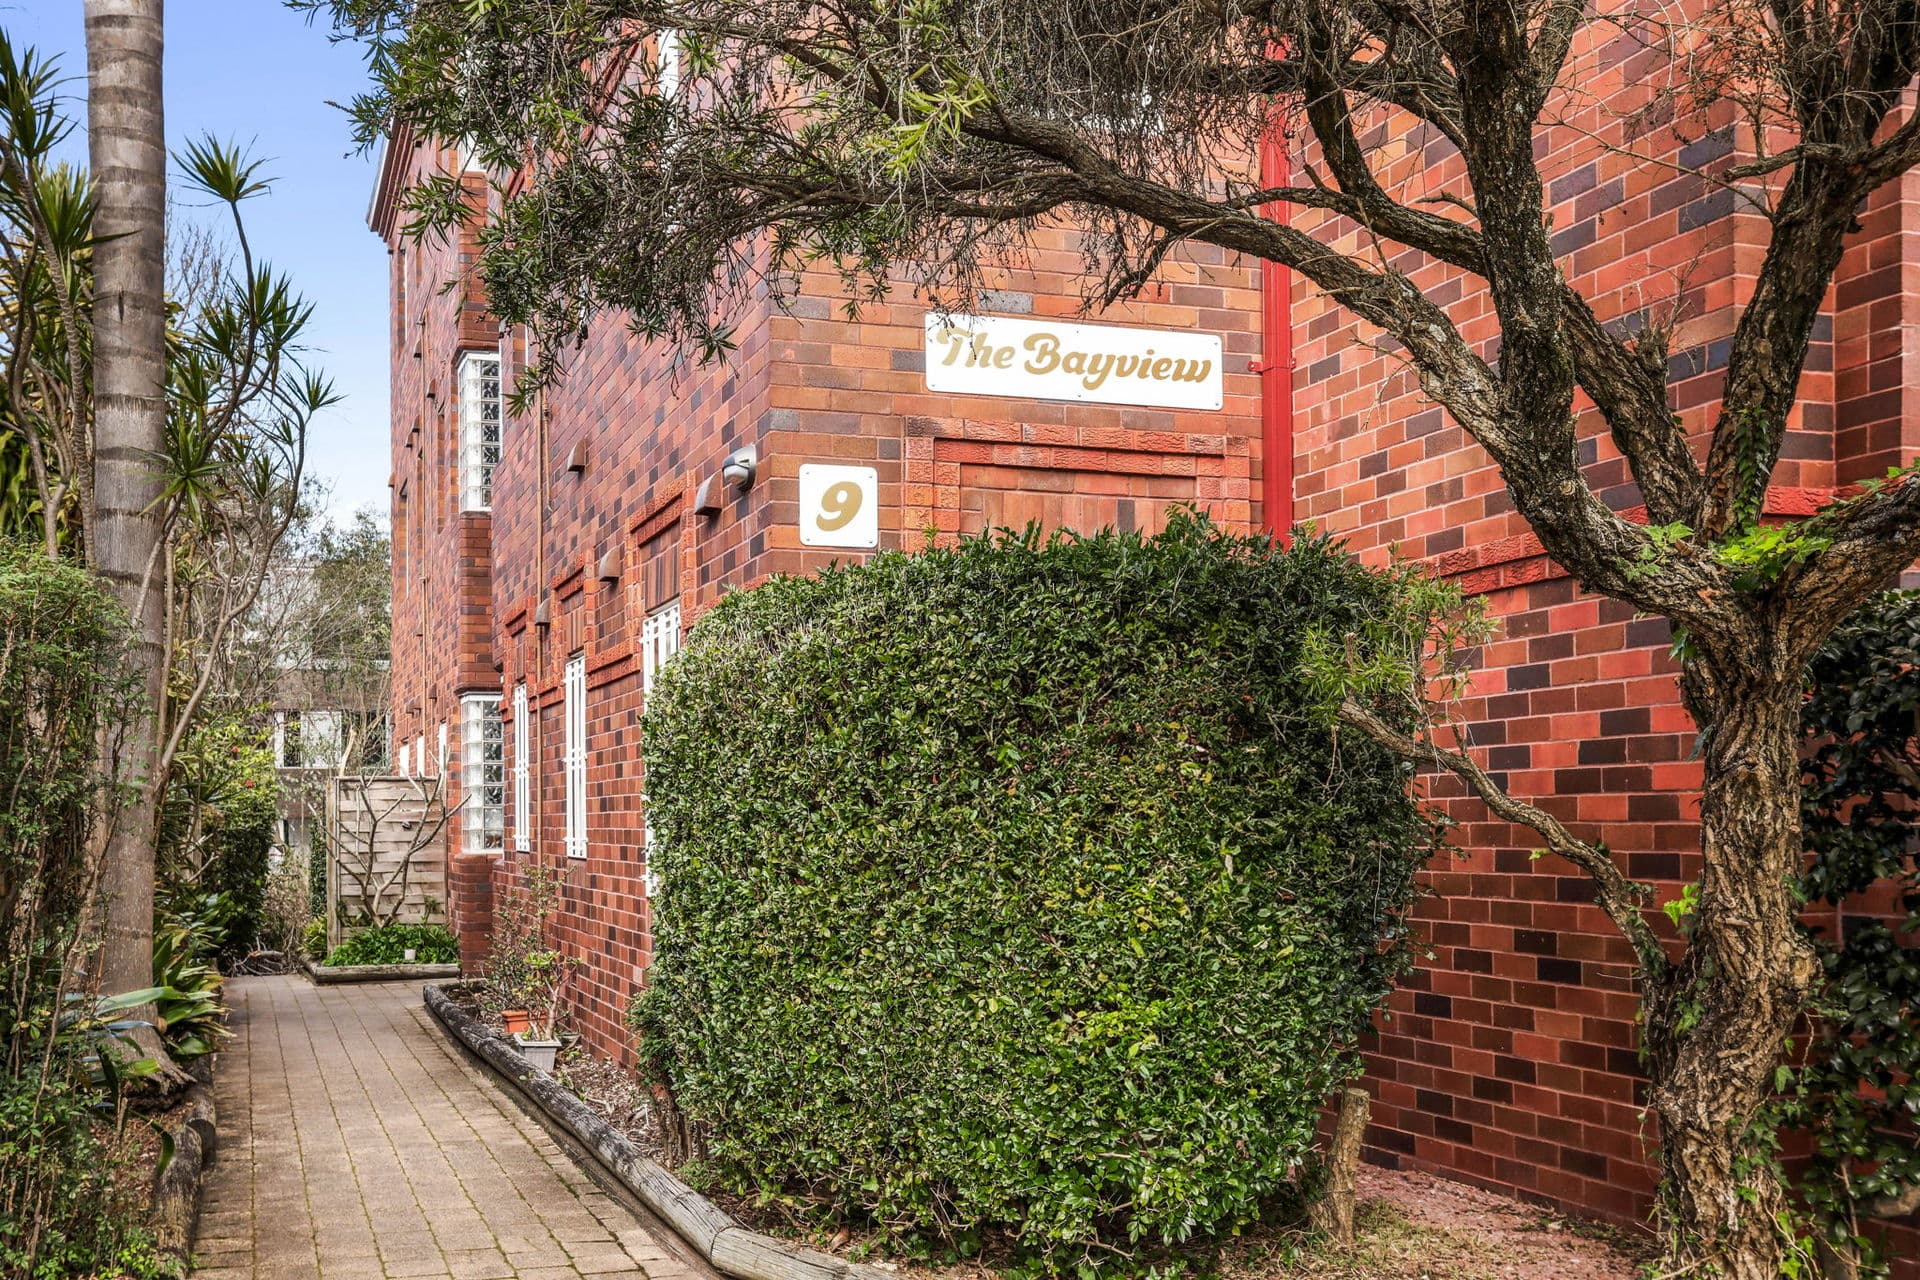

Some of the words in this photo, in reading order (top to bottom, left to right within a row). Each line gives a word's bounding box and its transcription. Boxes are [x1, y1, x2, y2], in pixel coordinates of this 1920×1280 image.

[936, 327, 1016, 369] The
[1023, 333, 1212, 391] Bayview
[815, 481, 864, 532] 9
